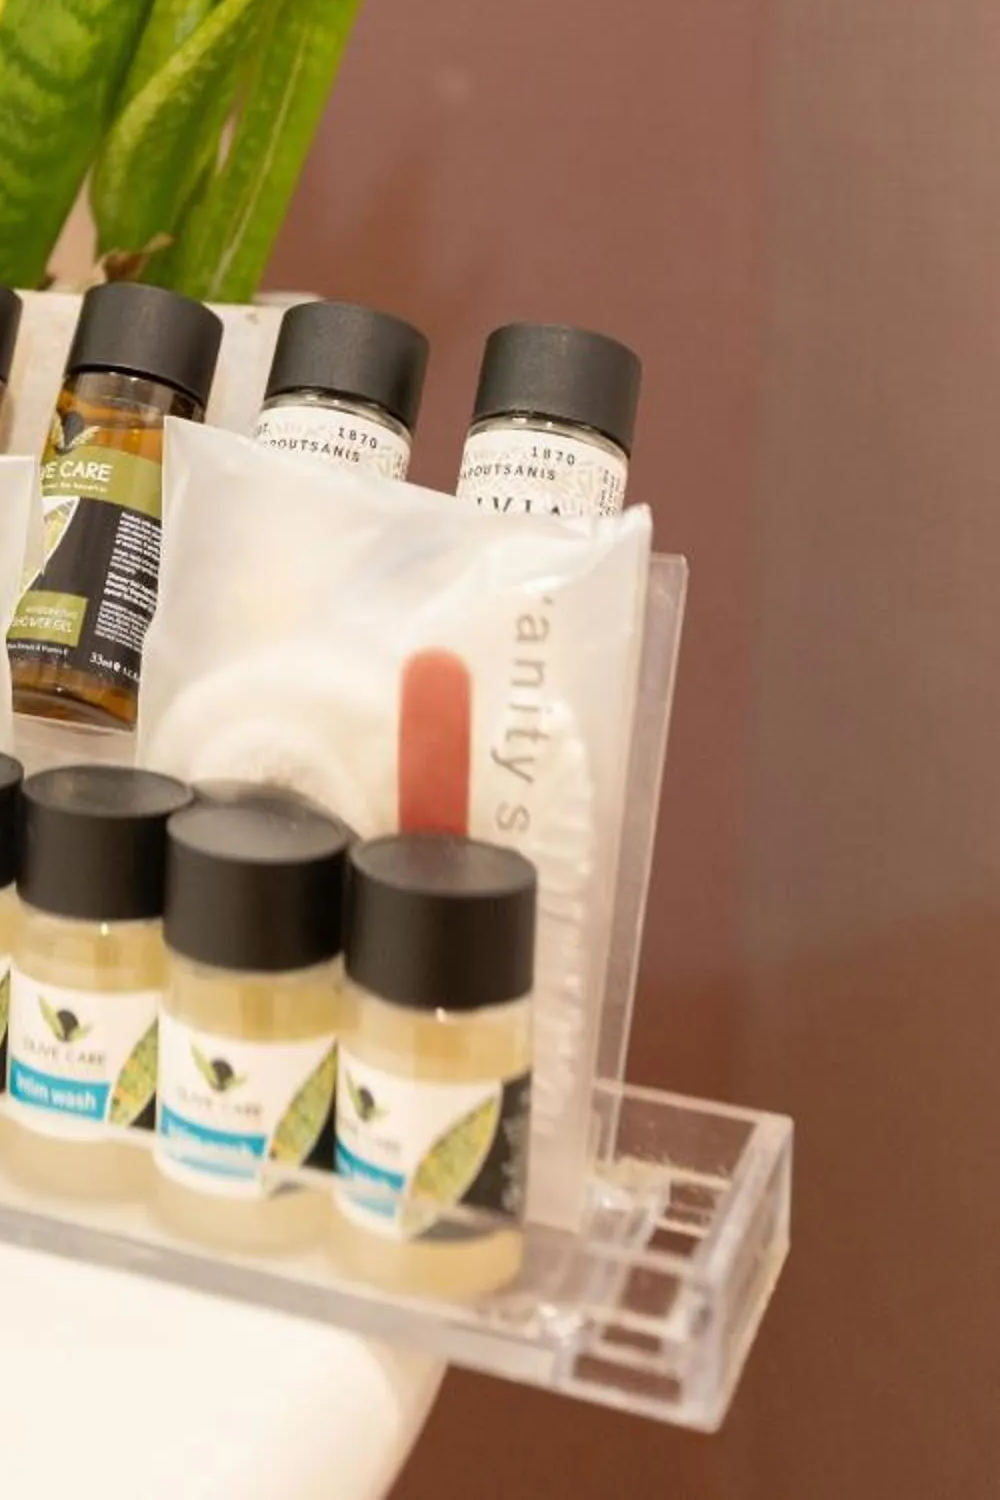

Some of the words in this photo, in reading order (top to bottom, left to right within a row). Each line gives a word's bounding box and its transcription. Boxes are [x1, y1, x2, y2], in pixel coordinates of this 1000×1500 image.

[338, 427, 378, 449] 1870
[266, 438, 360, 462] POUTSANIS
[532, 446, 575, 466] 1870
[60, 460, 113, 482] CARE
[491, 596, 556, 784] anity
[51, 1088, 98, 1111] wash
